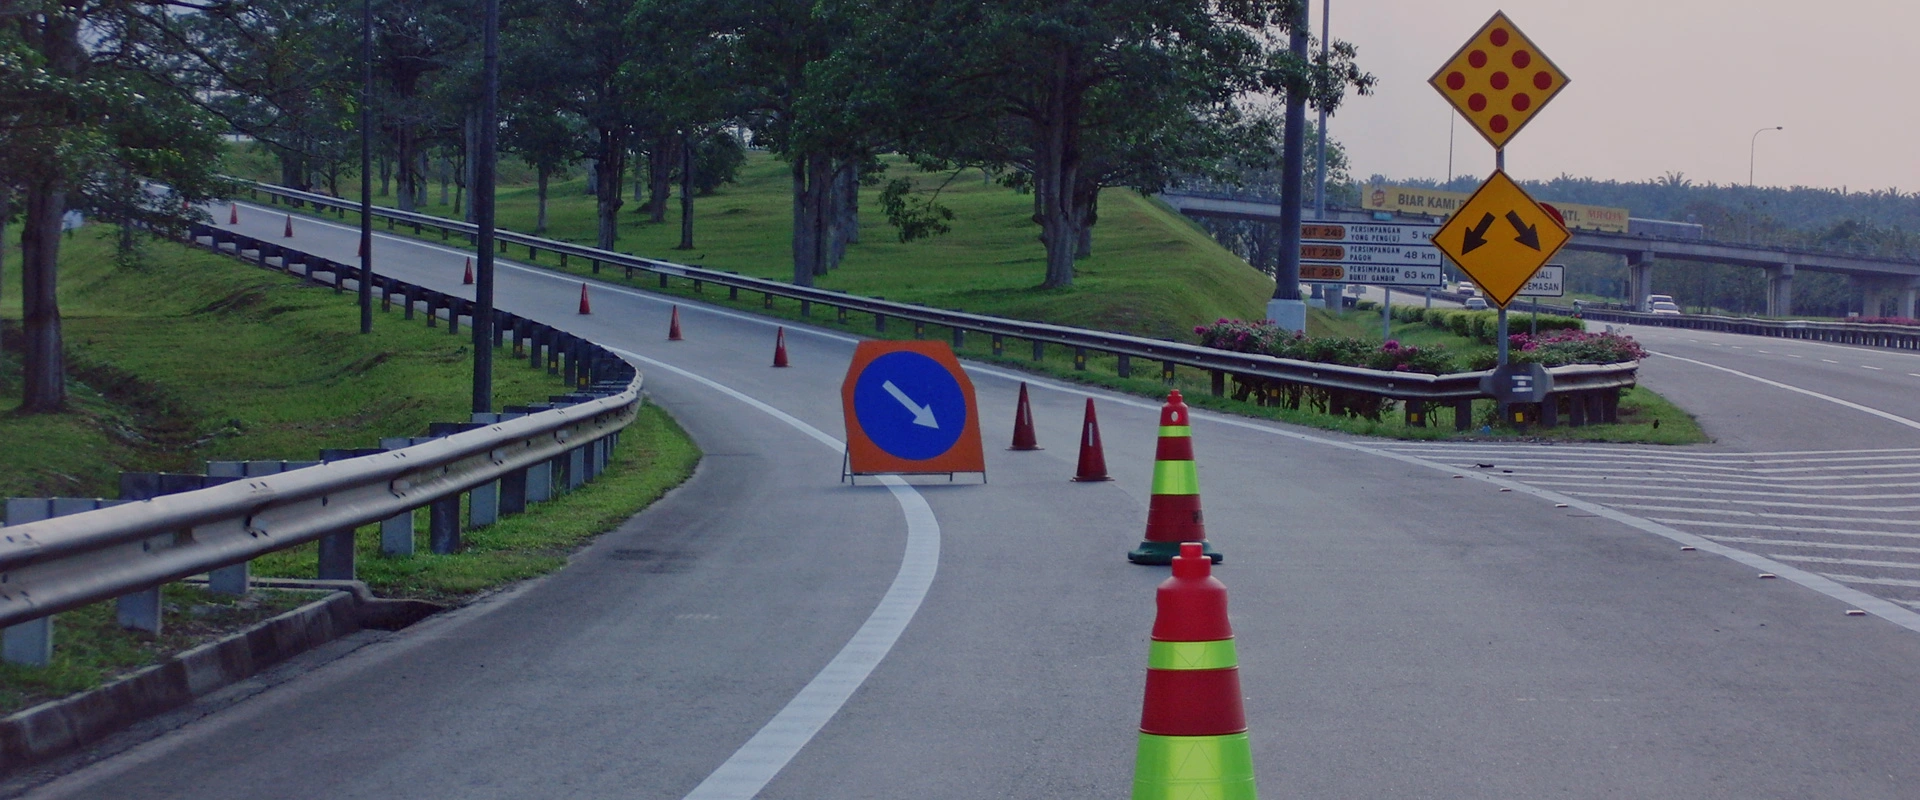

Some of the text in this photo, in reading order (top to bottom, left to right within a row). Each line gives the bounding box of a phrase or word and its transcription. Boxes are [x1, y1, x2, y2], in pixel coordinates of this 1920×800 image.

[1398, 193, 1424, 207] BIAR
[1427, 196, 1455, 210] KAMI
[1559, 208, 1580, 222] ATI.
[1301, 227, 1342, 237] XIT 241
[1351, 225, 1401, 234] PERSIMPANGAN
[1412, 230, 1418, 239] 5
[1301, 247, 1317, 256] XIT
[1350, 246, 1400, 254] PERSIMPANGAN
[1404, 251, 1436, 260] 48 km
[1300, 267, 1341, 277] XIT 236
[1349, 265, 1400, 274] PERSIMPANGAN
[1404, 271, 1435, 280] 63 km
[1535, 271, 1552, 279] UALI
